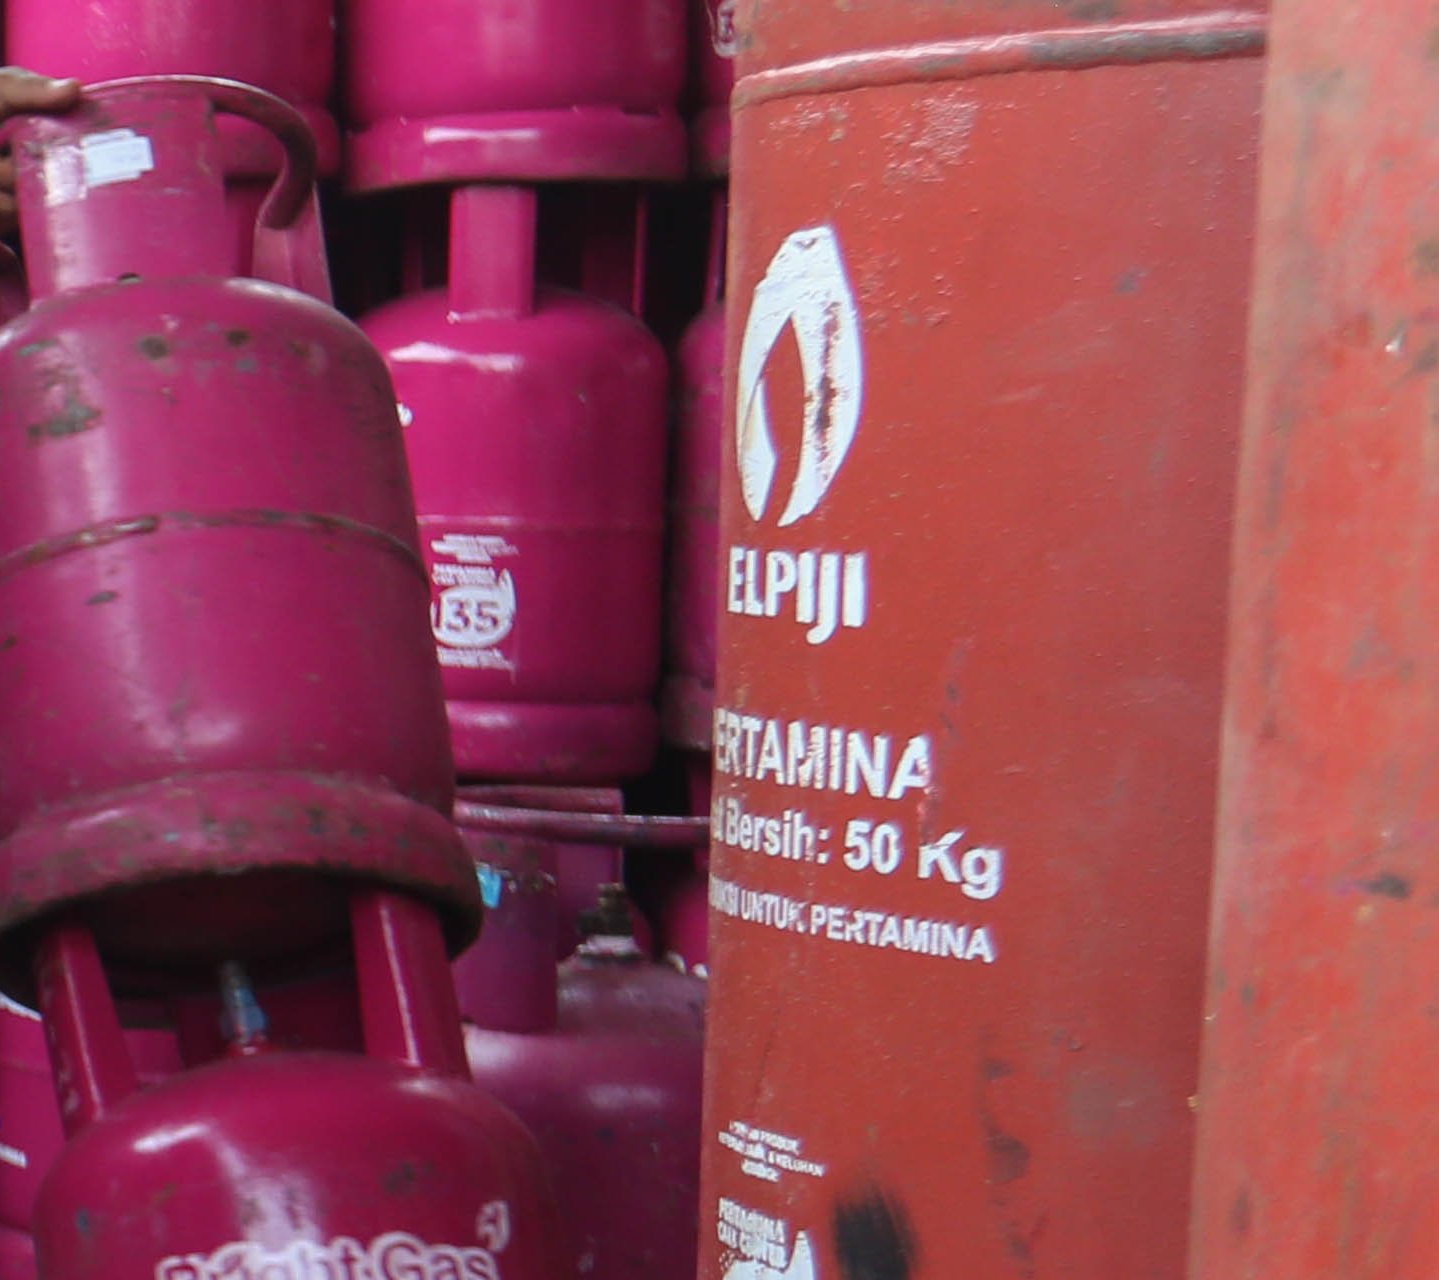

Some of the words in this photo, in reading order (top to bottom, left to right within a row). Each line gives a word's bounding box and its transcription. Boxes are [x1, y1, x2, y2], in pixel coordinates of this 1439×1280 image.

[728, 546, 867, 646] ELPIJI
[713, 707, 931, 800] ERTAMINA
[726, 798, 831, 865] Bersih:
[843, 819, 902, 875] 50
[917, 829, 1003, 901] Kg
[740, 887, 808, 933] UNTUK
[809, 903, 996, 964] PERTAMINA
